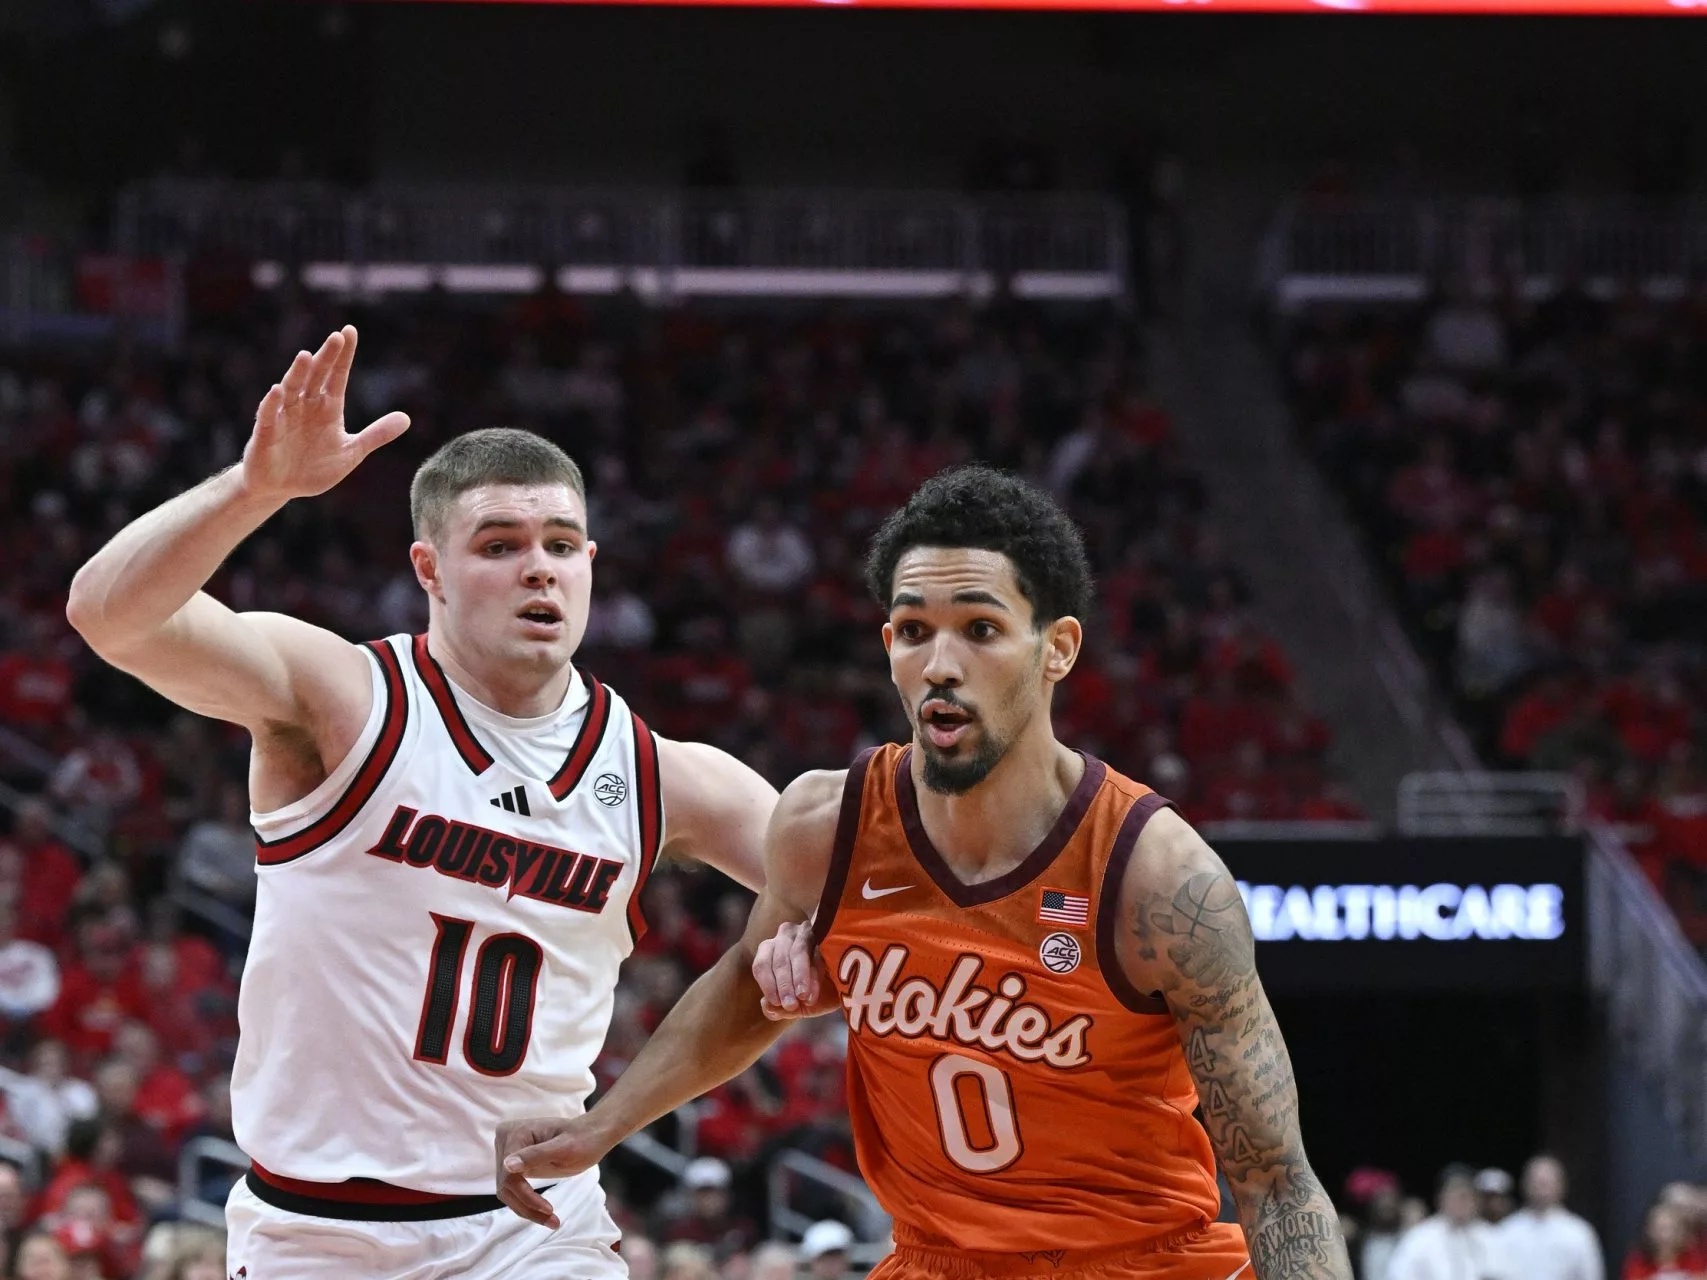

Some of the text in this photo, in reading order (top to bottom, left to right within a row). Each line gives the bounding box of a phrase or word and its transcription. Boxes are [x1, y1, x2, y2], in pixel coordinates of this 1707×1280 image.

[597, 783, 626, 794] ACC
[365, 805, 625, 914] LOUISVILLE
[1236, 880, 1565, 941] EALTHCARE
[1047, 947, 1078, 958] ACC
[413, 911, 544, 1077] 10
[837, 943, 1094, 1069] Hokies
[1190, 1026, 1217, 1073] 4
[928, 1053, 1024, 1174] 0
[1209, 1079, 1241, 1120] 4
[1232, 1126, 1263, 1163] 4
